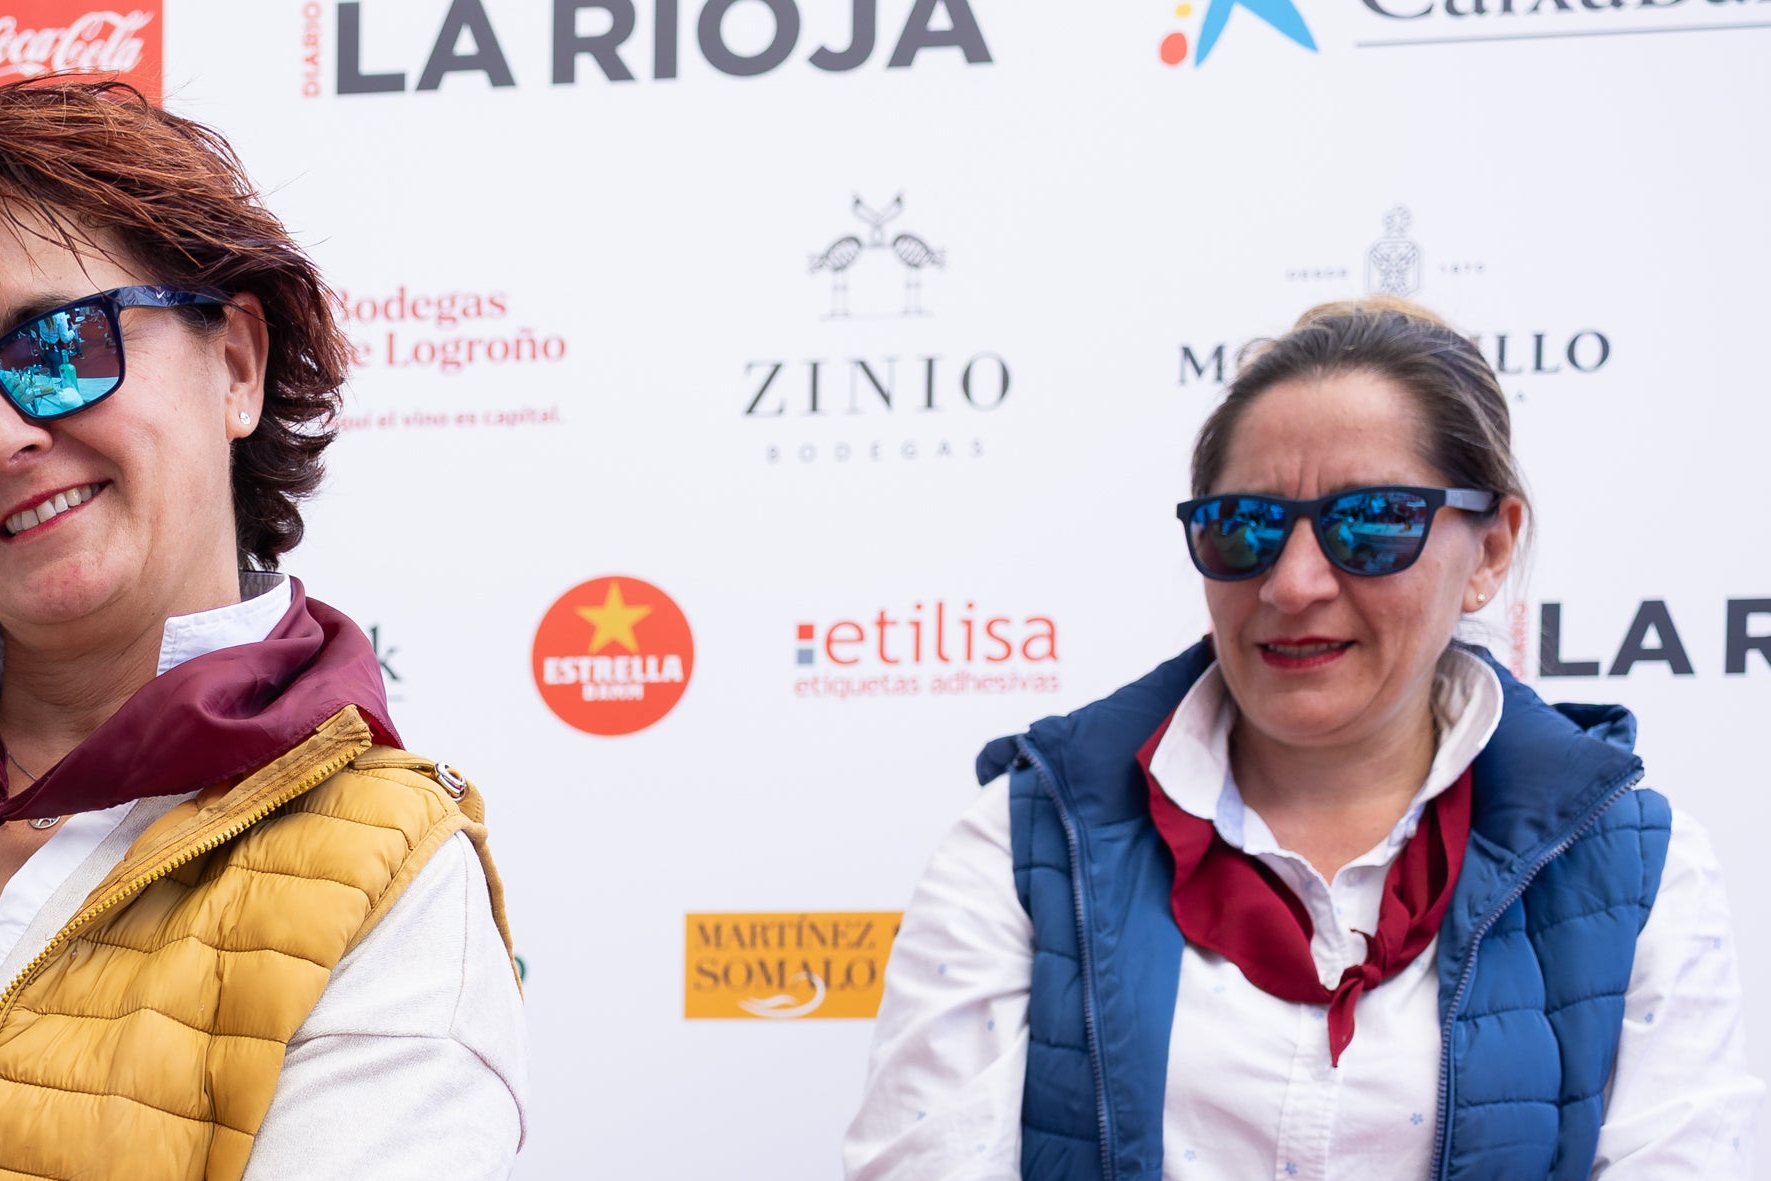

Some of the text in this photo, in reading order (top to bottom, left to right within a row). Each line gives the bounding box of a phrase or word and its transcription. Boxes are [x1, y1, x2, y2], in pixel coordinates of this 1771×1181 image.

[336, 0, 993, 95] LA RIOJA
[385, 326, 568, 374] Logroño
[744, 352, 1012, 418] ZINIO
[825, 601, 1059, 666] etilisa
[1539, 599, 1695, 678] LA
[543, 655, 685, 685] ESTRELLA
[794, 664, 1060, 697] etiquetas adhesivas
[696, 913, 878, 949] MARTÍNEZ
[694, 957, 878, 993] SOMALO
